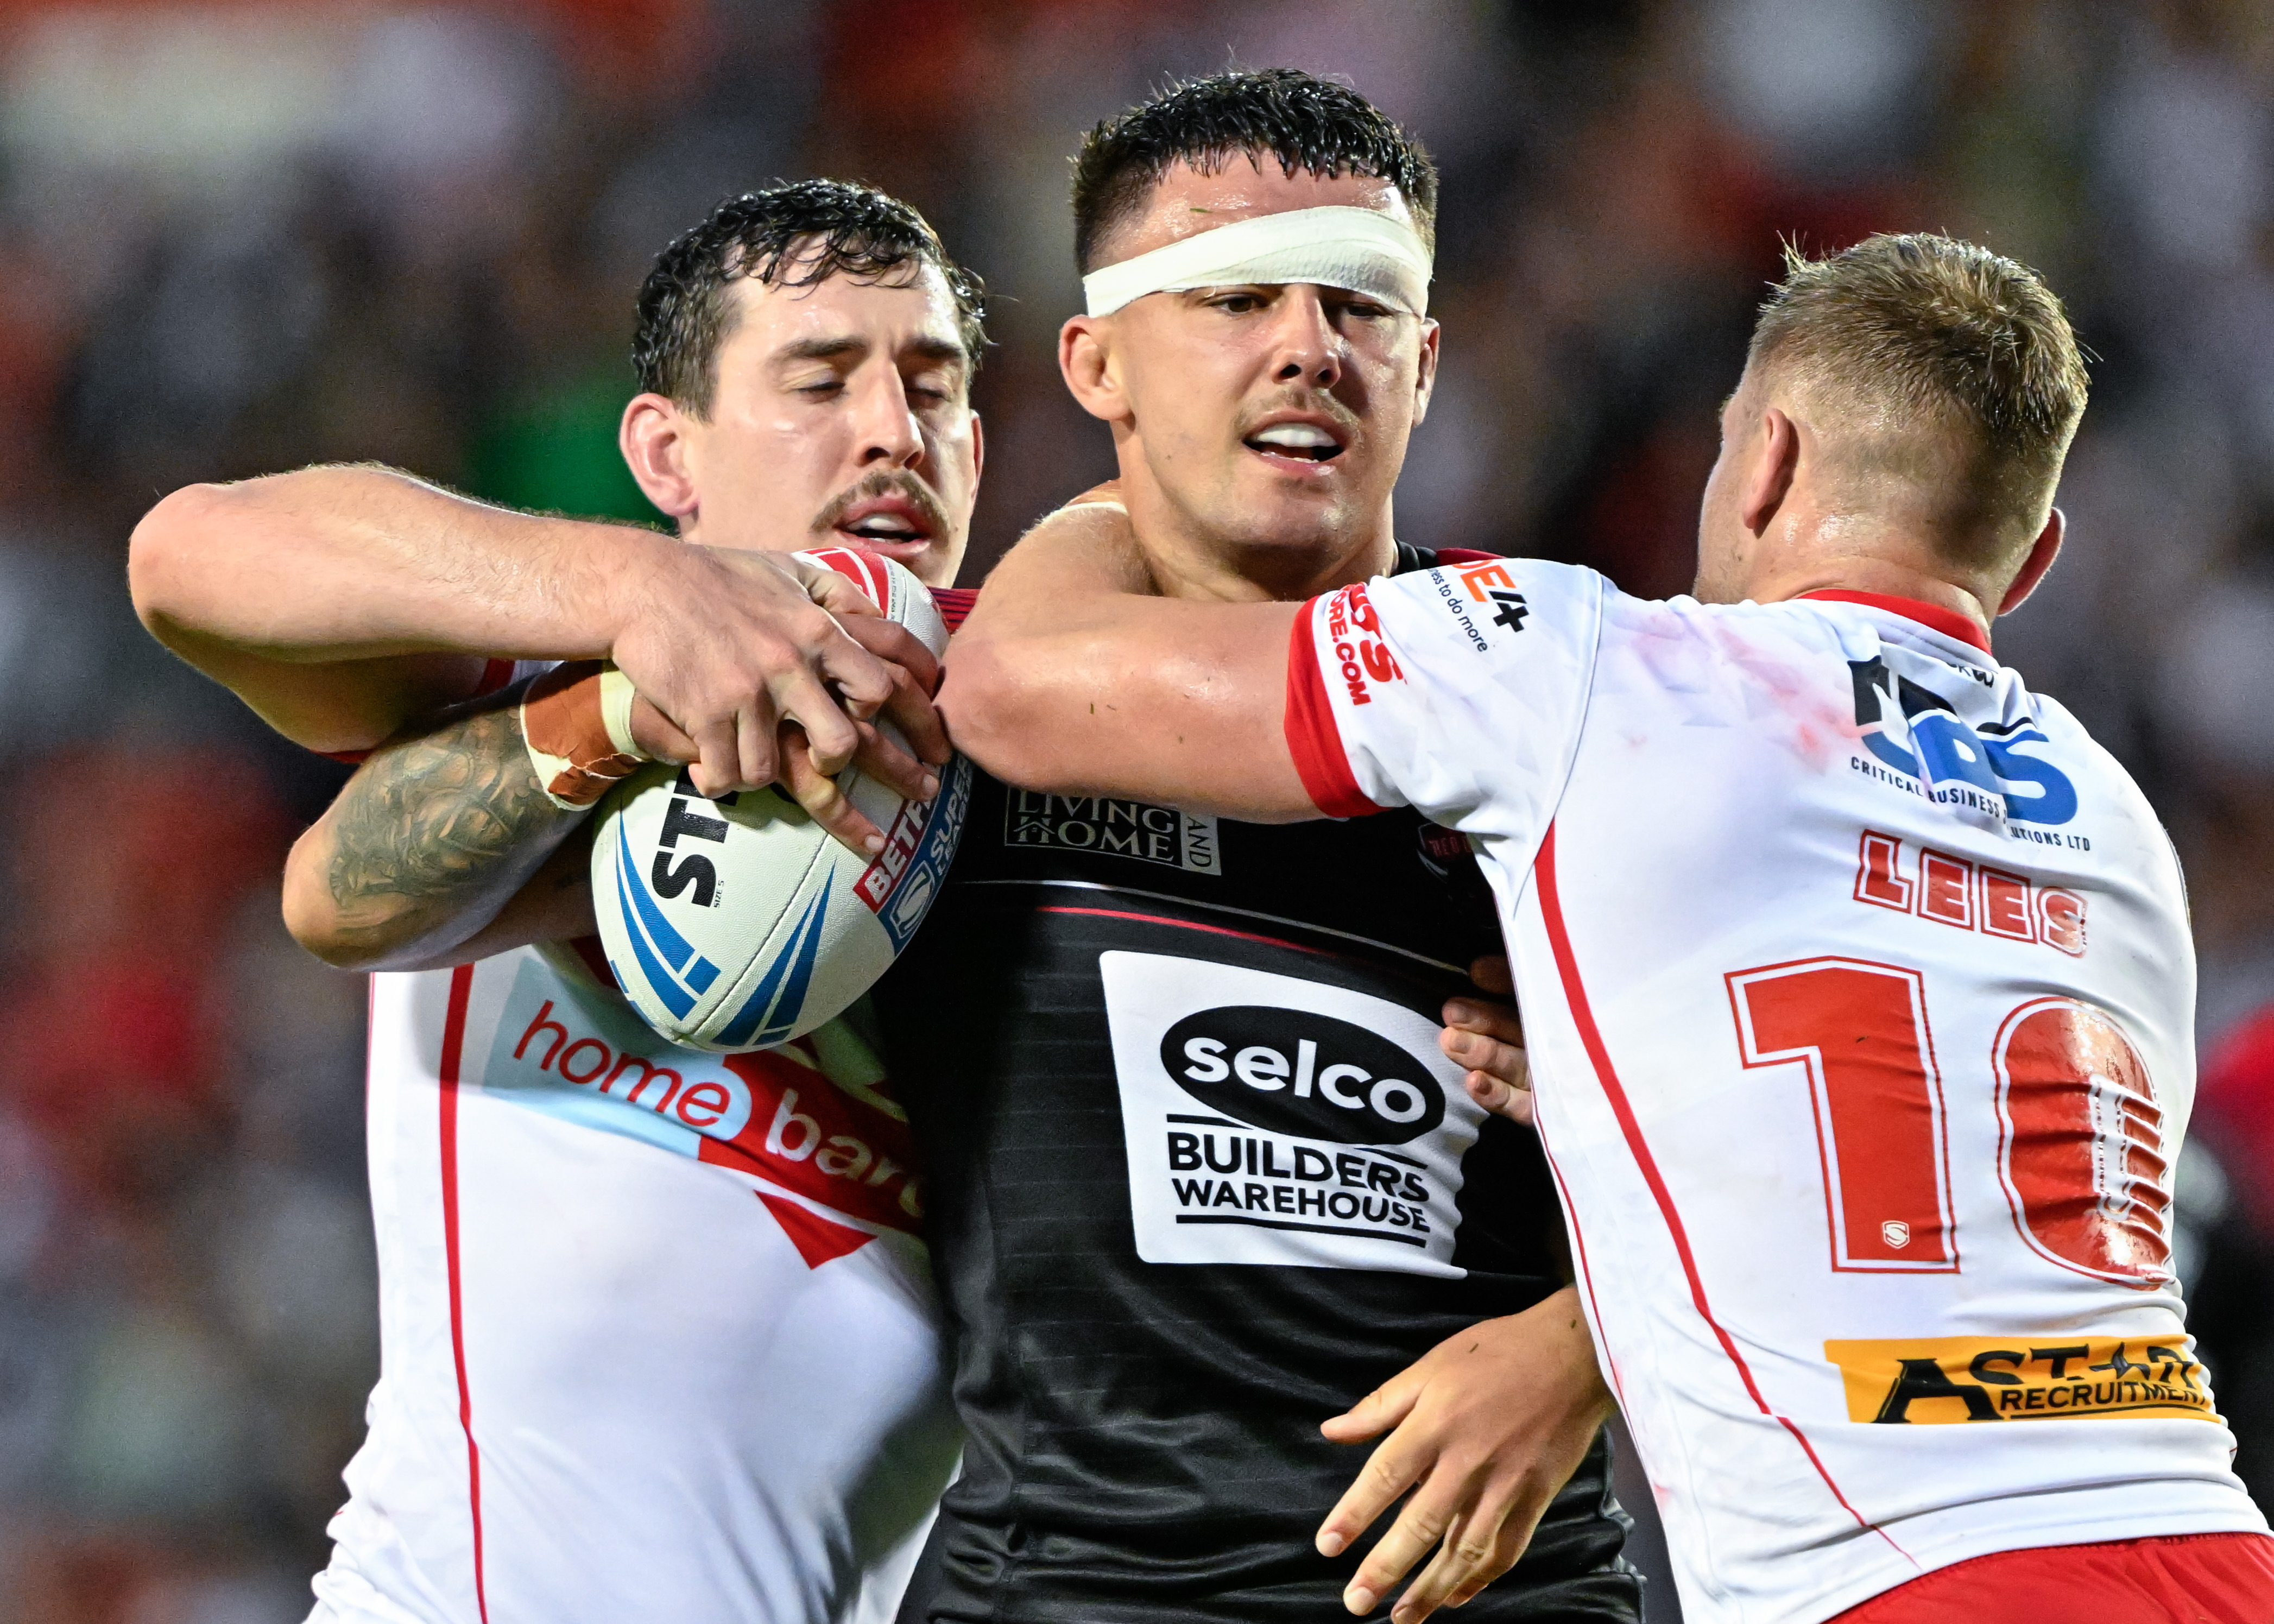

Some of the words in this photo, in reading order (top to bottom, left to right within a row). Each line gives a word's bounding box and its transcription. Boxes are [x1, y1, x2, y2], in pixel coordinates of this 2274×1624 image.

[1329, 585, 1372, 705] ORE.COM
[1439, 584, 1451, 597] to
[1447, 598, 1463, 614] do
[1457, 616, 1488, 652] more
[1013, 816, 1174, 862] HOME
[1018, 789, 1174, 833] LIVING
[1188, 816, 1211, 867] AND
[1851, 756, 1923, 797] CRITICAL
[1928, 788, 2000, 818] BUSINESS
[2067, 835, 2090, 851] LTD
[864, 799, 931, 904] BETF
[713, 889, 723, 908] SIZE
[1853, 829, 2088, 959] LEES
[512, 1000, 731, 1127] home
[1184, 1038, 1426, 1123] selco
[1723, 956, 2176, 1291] 10
[1167, 1132, 1430, 1202] BUILDERS
[1172, 1178, 1430, 1233] WAREHOUSE
